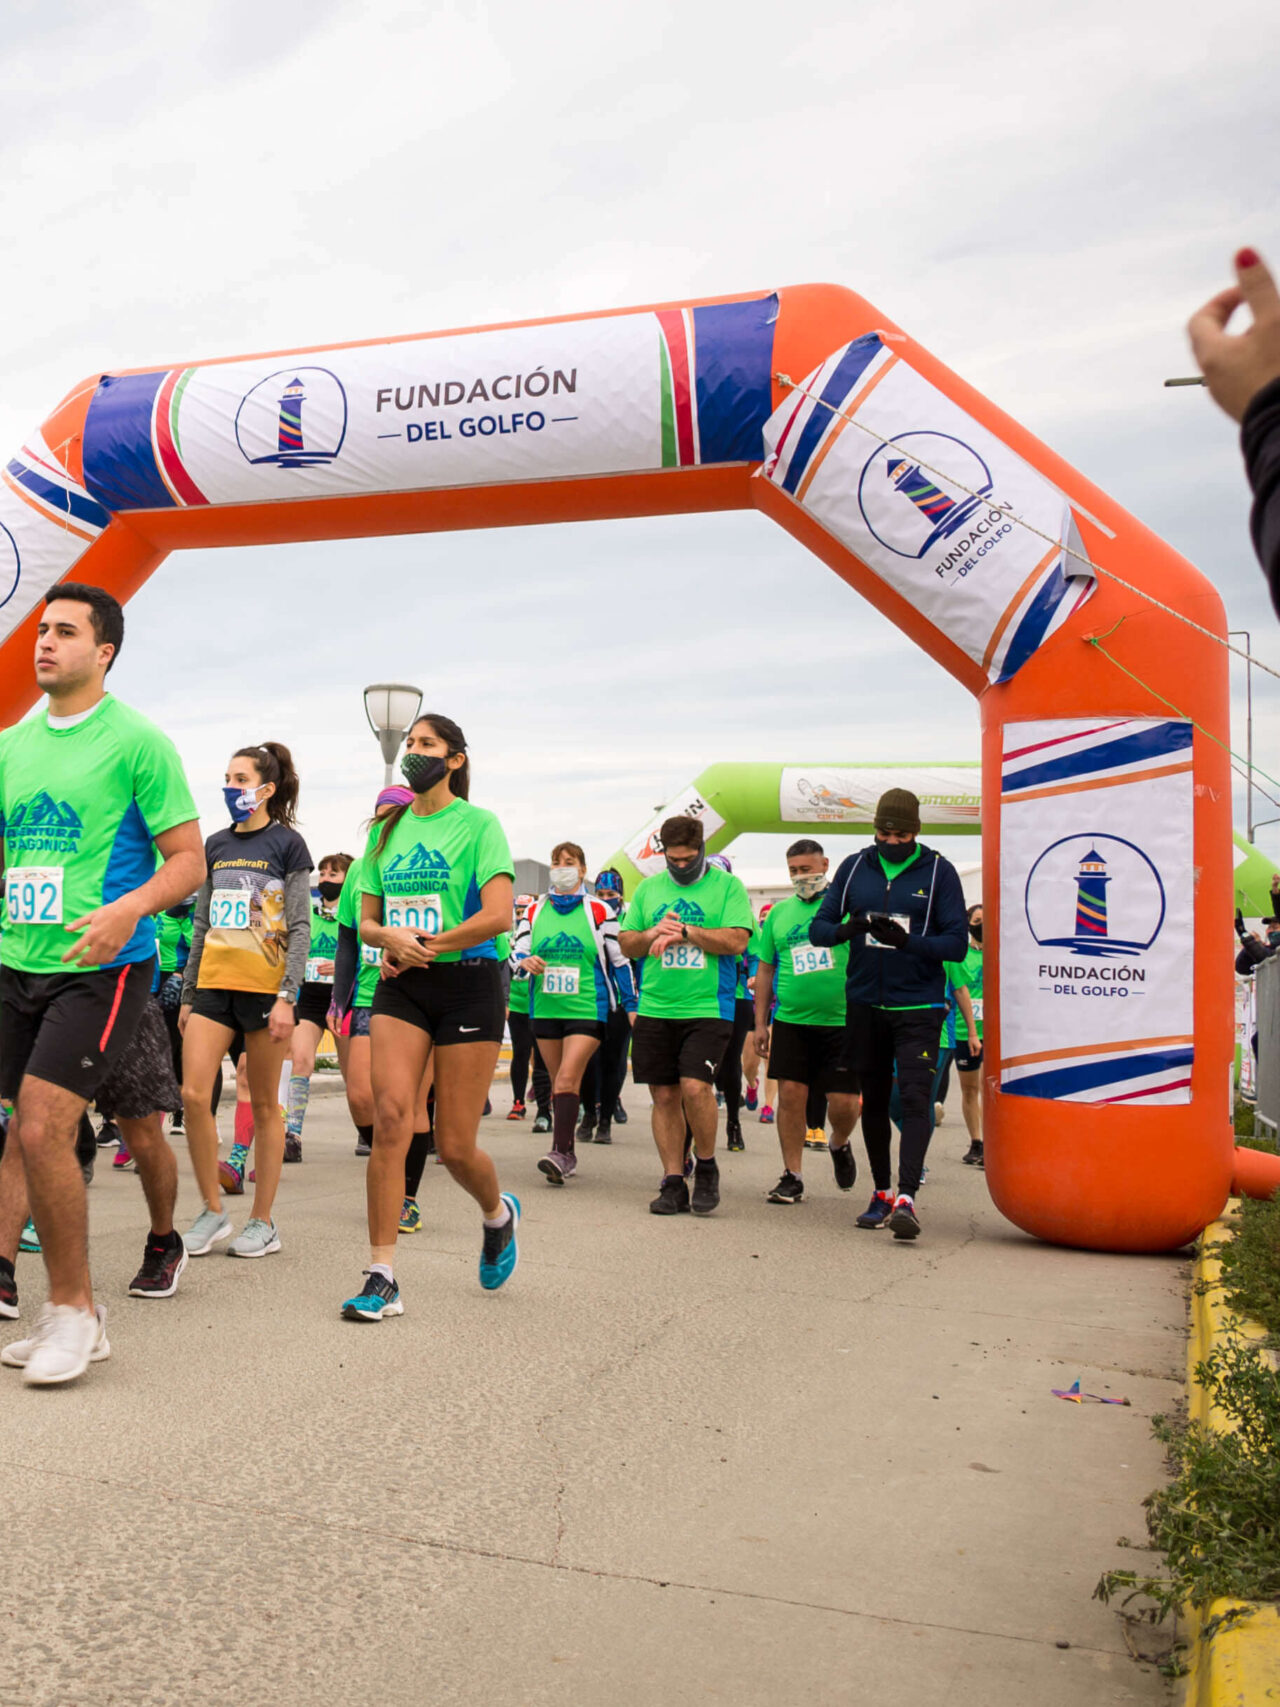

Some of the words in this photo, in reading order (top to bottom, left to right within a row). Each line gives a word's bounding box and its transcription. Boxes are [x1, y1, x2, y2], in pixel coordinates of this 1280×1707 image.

[376, 366, 577, 412] FUNDACIÓN
[406, 420, 452, 443] DEL
[458, 411, 545, 438] GOLFO
[935, 501, 1013, 578] FUNDACIÓN
[958, 557, 978, 577] DEL
[976, 523, 1012, 557] GOLFO
[8, 839, 78, 853] PAGONICA
[383, 871, 451, 882] AVENTURA
[384, 881, 449, 893] PATAGONICA
[8, 882, 57, 921] 592
[211, 900, 247, 926] 626
[389, 907, 439, 935] 600
[664, 945, 702, 967] 582
[795, 950, 830, 973] 594
[547, 974, 575, 992] 618
[1039, 965, 1146, 981] FUNDACIÓN
[1054, 985, 1077, 995] DEL
[1081, 986, 1129, 997] GOLFO
